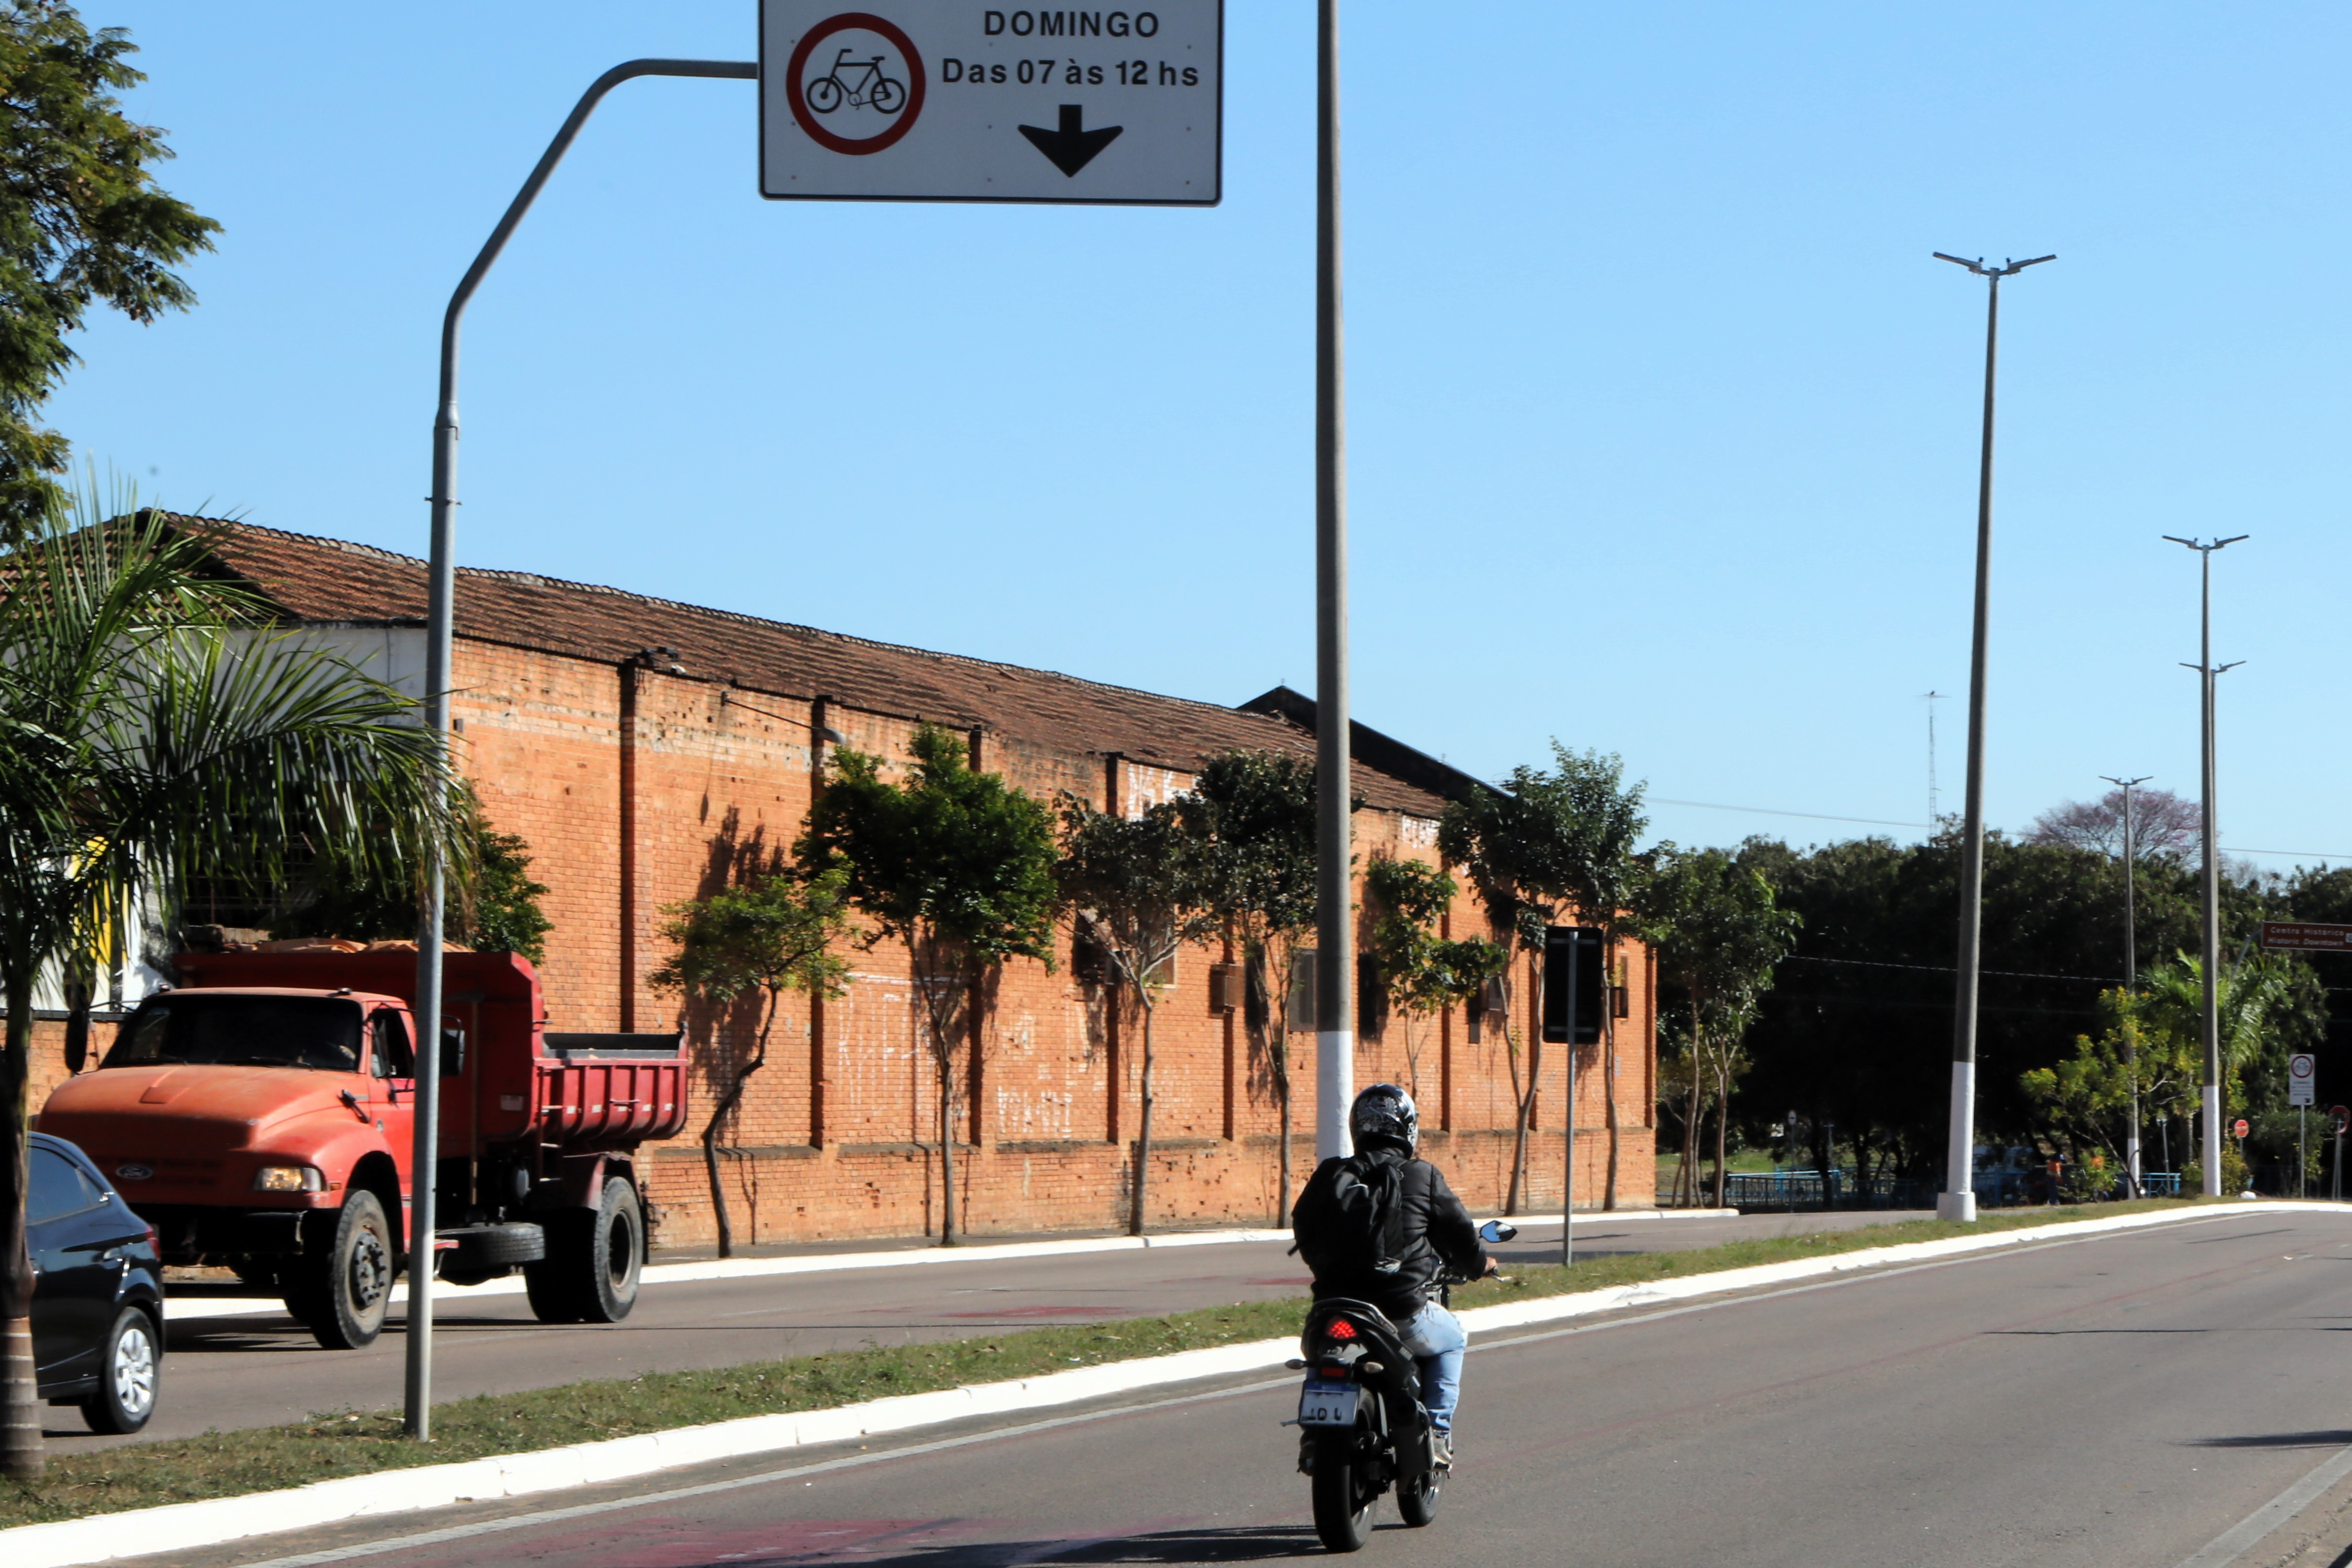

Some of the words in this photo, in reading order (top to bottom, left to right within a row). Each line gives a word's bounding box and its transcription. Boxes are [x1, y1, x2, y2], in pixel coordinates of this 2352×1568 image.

[985, 10, 1158, 38] DOMINGO
[943, 58, 1006, 83] Das
[1017, 59, 1055, 84] 07
[1065, 59, 1103, 84] às
[1116, 60, 1147, 84] 12
[1160, 61, 1198, 86] hs
